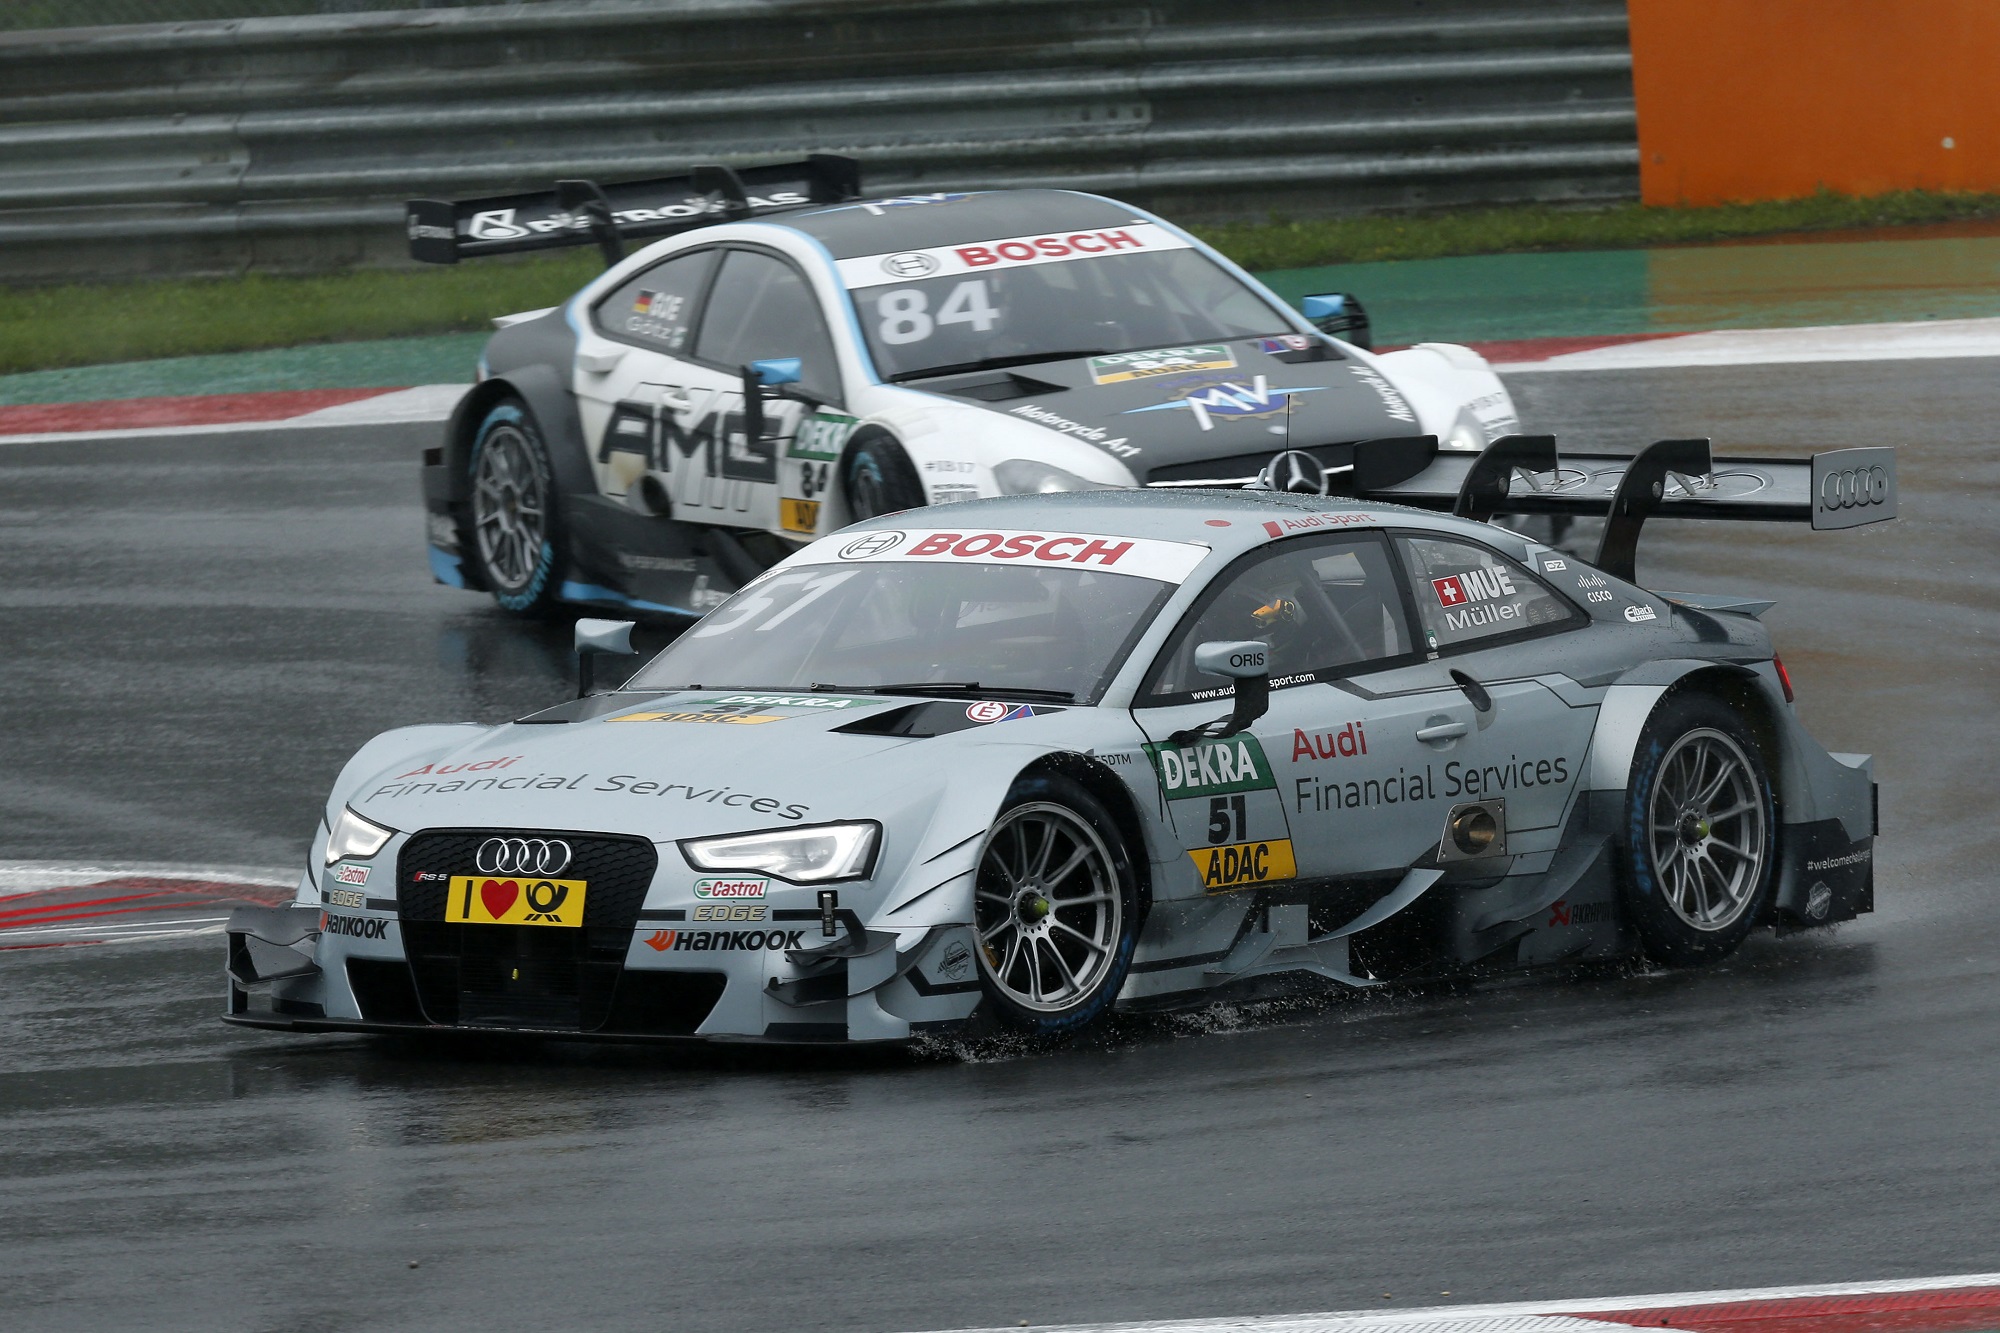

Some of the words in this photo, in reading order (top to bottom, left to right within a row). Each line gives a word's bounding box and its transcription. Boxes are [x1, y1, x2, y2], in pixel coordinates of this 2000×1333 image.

[954, 230, 1144, 267] BOSCH
[877, 279, 1000, 345] 84
[1186, 375, 1268, 431] MV
[1009, 404, 1107, 441] Motorcycle
[1100, 437, 1142, 458] Art
[1283, 515, 1325, 530] Audi
[1322, 513, 1377, 527] Sport
[905, 533, 1135, 565] BOSCH
[1459, 565, 1517, 602] MUE
[692, 570, 861, 638] 51
[1445, 602, 1521, 631] Müller
[1230, 653, 1264, 668] ORIS
[653, 713, 748, 723] ADAC
[701, 705, 775, 715] 51
[715, 695, 852, 708] DEKRA
[1292, 721, 1368, 763] Audi
[394, 755, 525, 780] Audi
[1160, 741, 1259, 790] DEKRA
[1296, 764, 1436, 814] Financial
[1444, 754, 1569, 798] Services
[364, 772, 589, 803] Financial
[594, 774, 811, 820] Services
[1208, 795, 1247, 845] 51
[341, 865, 369, 884] Castrol
[1206, 843, 1269, 886] ADAC
[330, 889, 365, 909] EDGE
[462, 880, 474, 919] I
[712, 881, 763, 897] Castrol
[692, 905, 769, 922] EDGE
